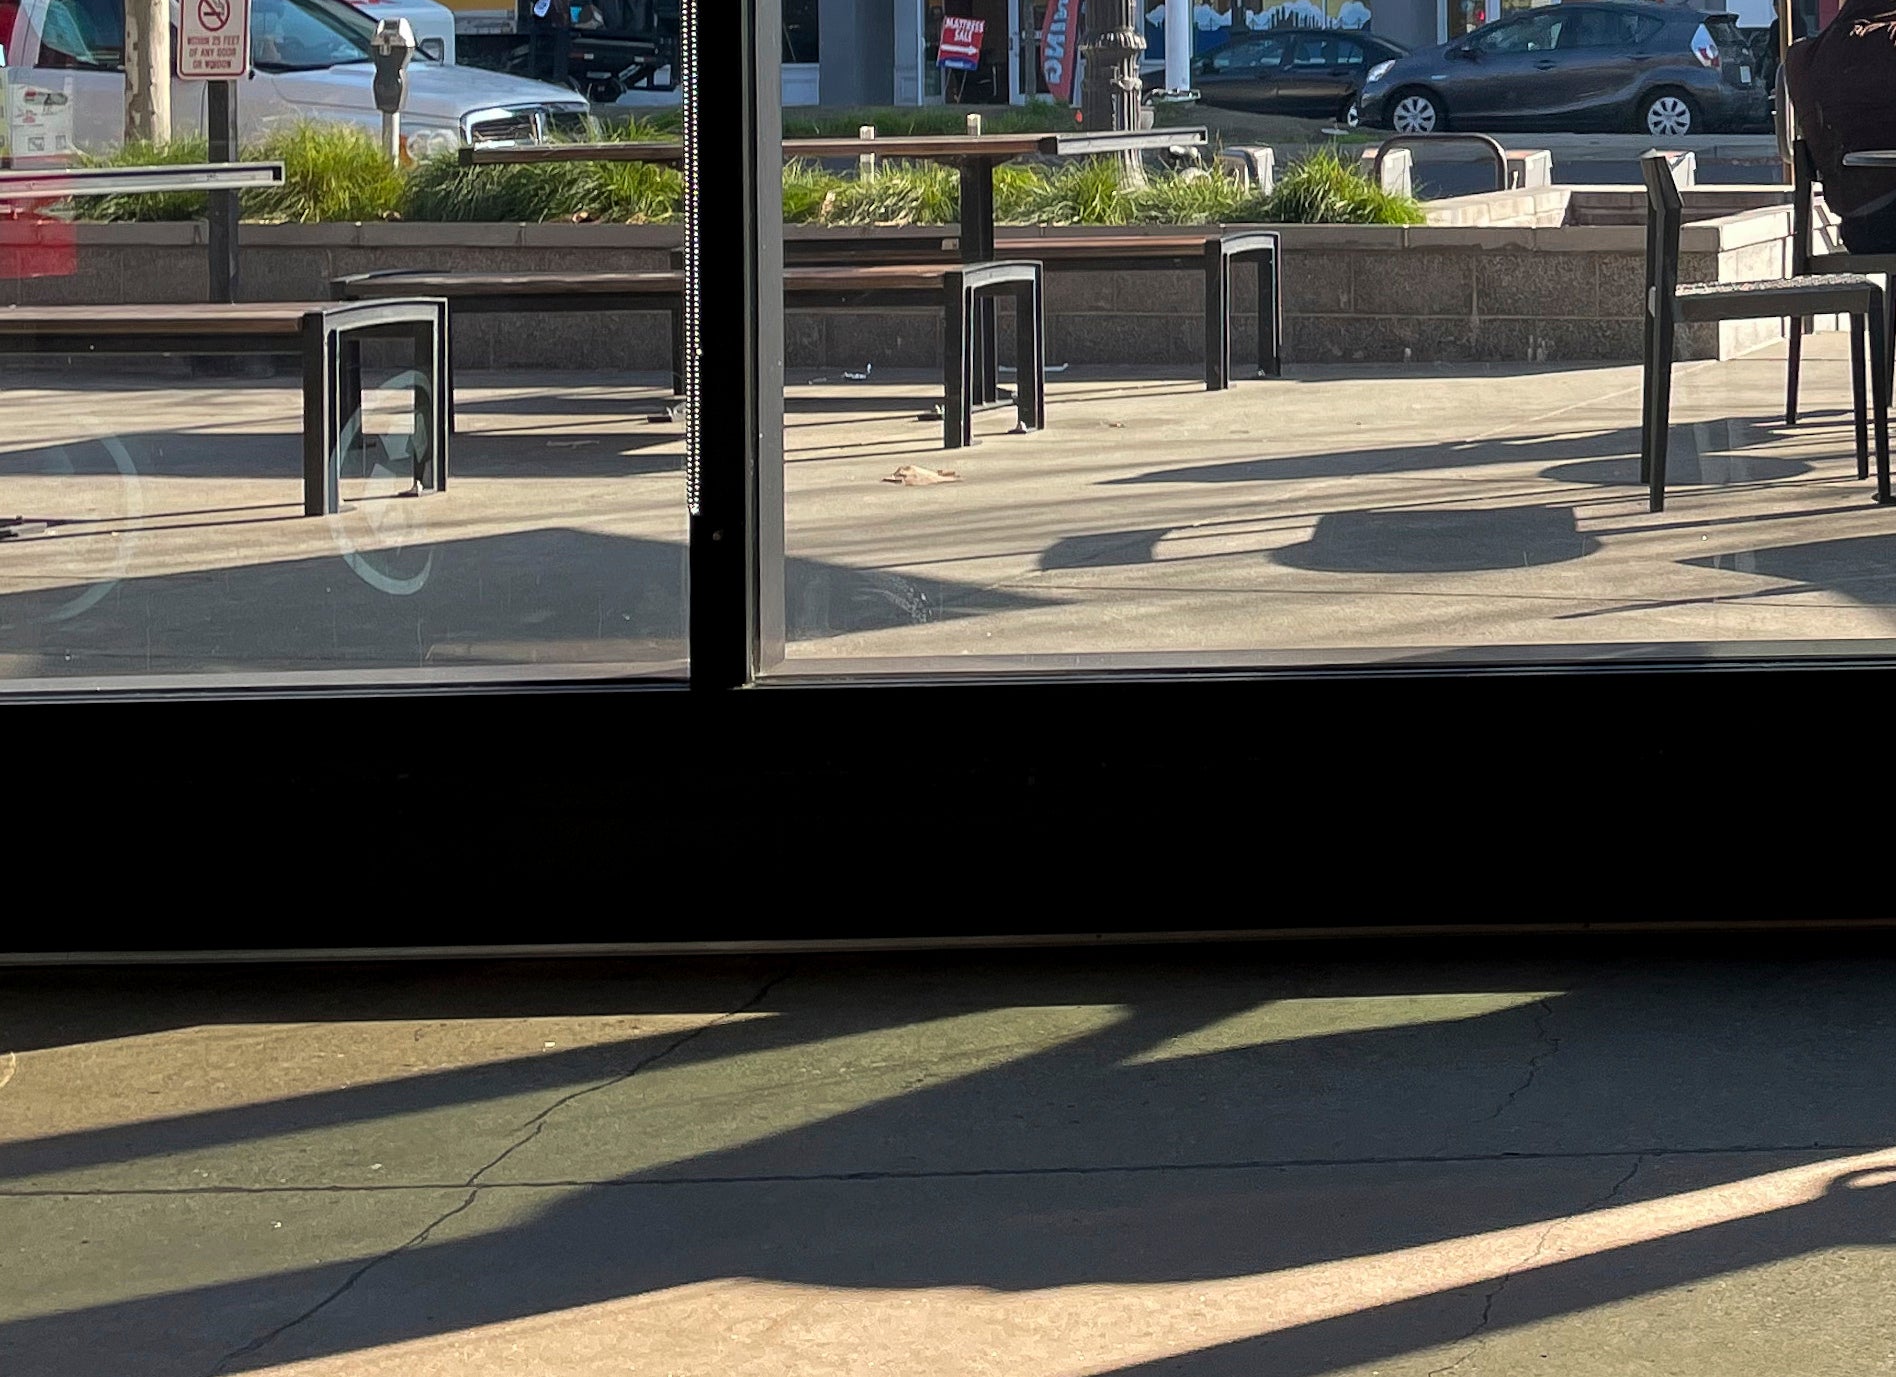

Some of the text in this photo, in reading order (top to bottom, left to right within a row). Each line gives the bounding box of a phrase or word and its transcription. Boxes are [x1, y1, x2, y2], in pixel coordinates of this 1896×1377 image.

[945, 17, 985, 33] MATTRESS
[223, 35, 240, 45] FEET
[954, 29, 972, 42] SALE
[201, 48, 214, 57] ANY
